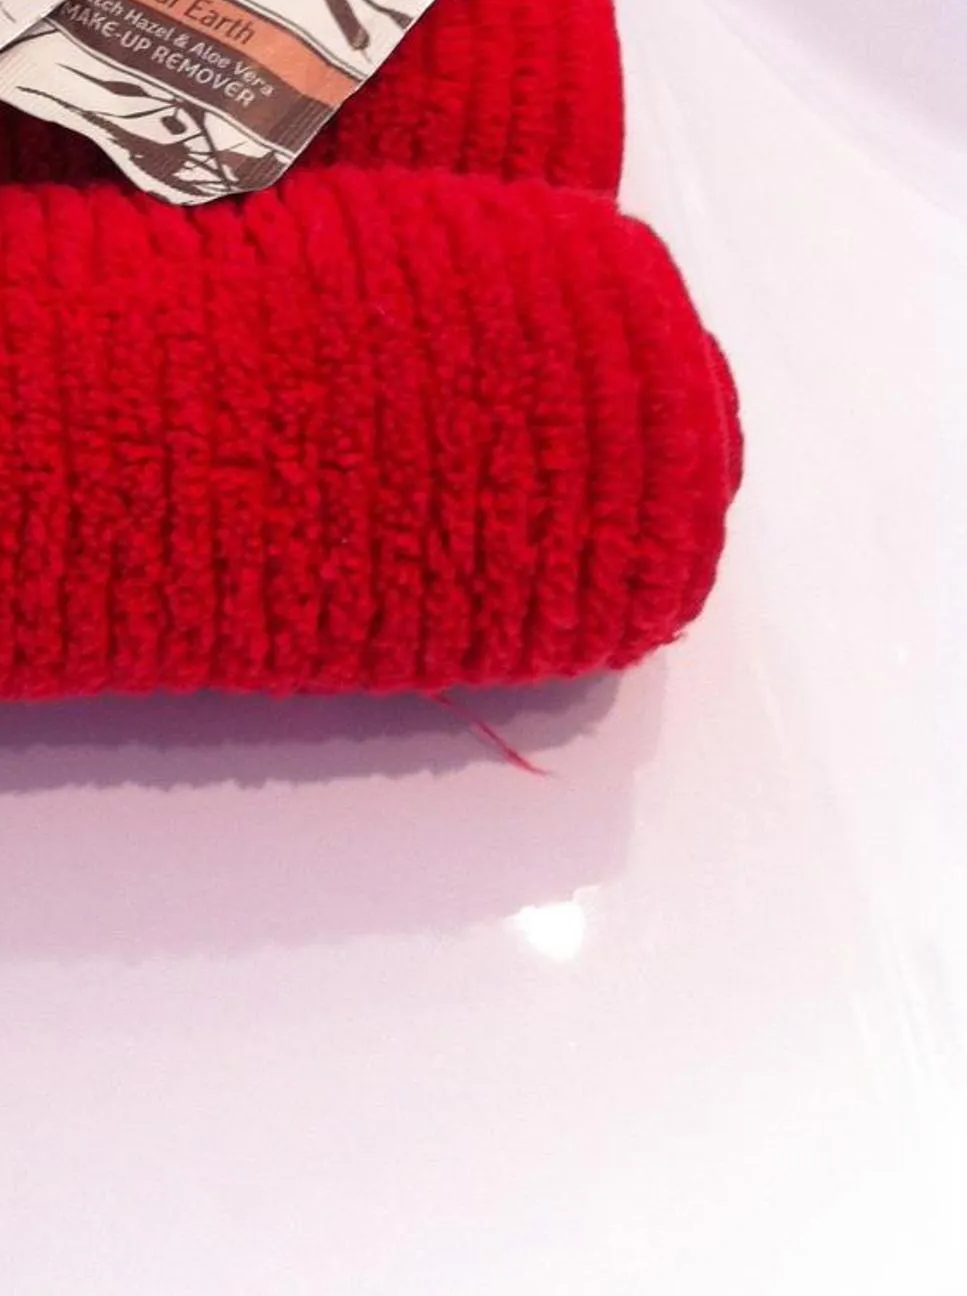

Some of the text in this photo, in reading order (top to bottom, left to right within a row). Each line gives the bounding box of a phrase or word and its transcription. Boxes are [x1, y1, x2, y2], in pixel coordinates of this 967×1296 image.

[59, 4, 256, 107] MAKE-UP REMOVER
[123, 7, 174, 41] Hazel
[174, 34, 188, 49] &
[189, 41, 229, 69] Aloe
[232, 61, 275, 97] Vera
